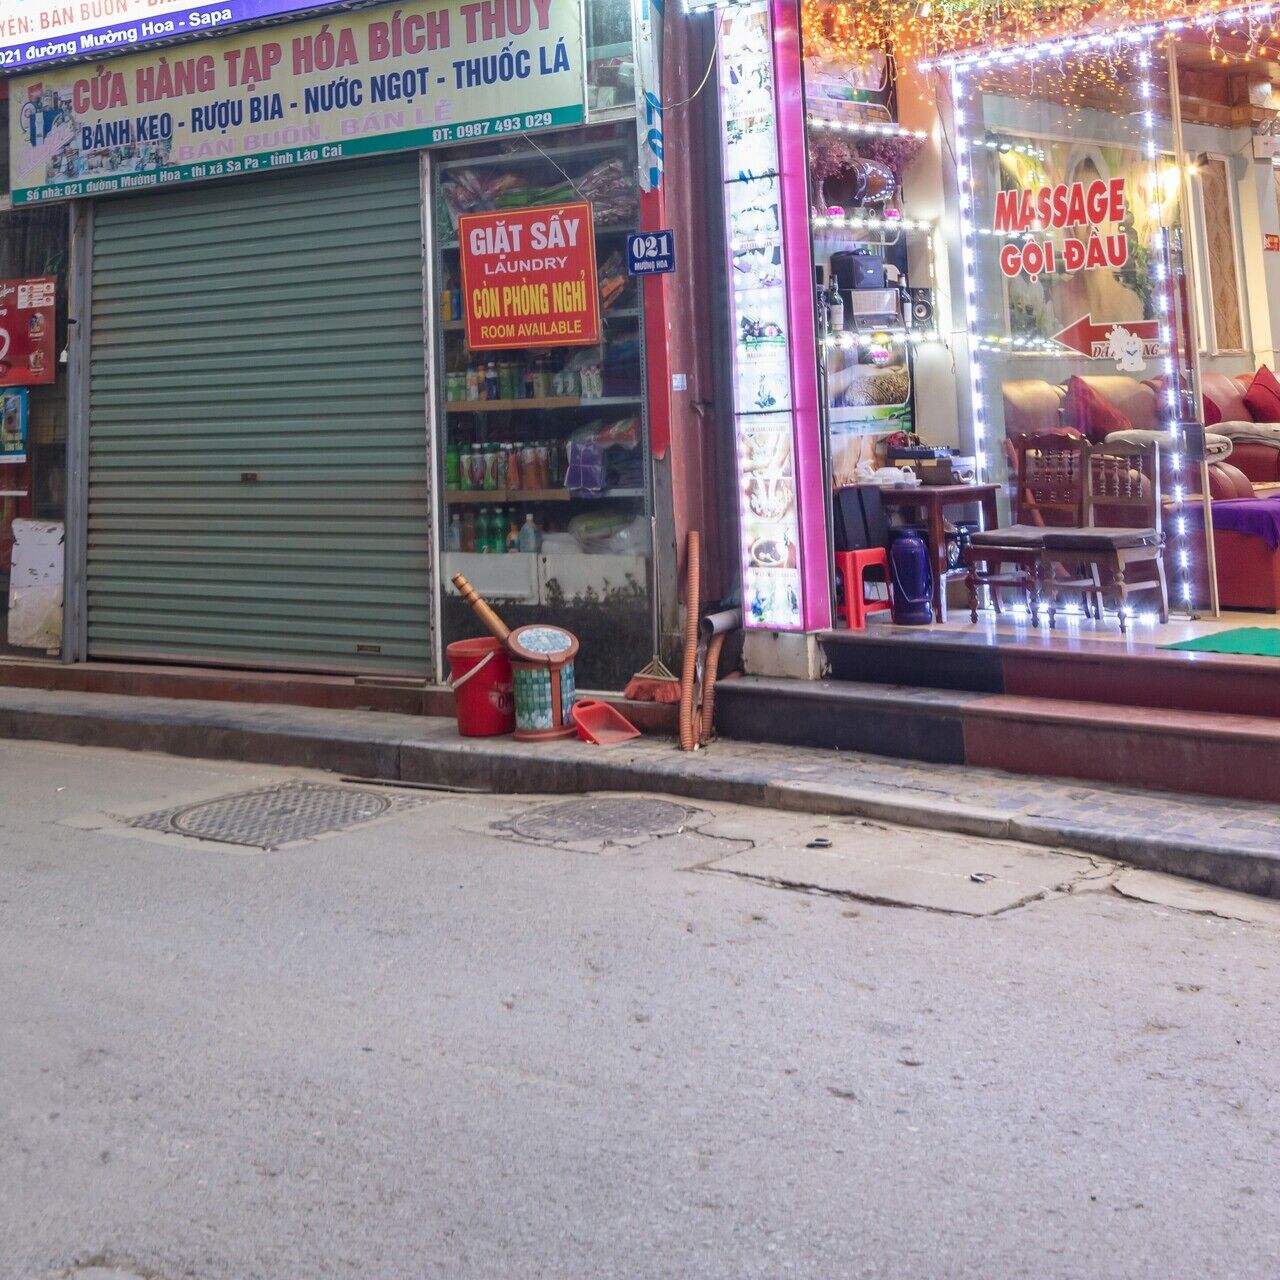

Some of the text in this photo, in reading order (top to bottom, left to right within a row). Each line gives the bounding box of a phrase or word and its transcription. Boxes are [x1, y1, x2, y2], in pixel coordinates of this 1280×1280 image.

[25, 34, 77, 62] đường
[80, 21, 138, 49] Mường
[144, 19, 175, 41] Hoa
[189, 8, 233, 32] Sapa
[72, 64, 128, 115] CỬA
[136, 55, 216, 104] HÀNG
[223, 42, 282, 92] TẠP
[292, 23, 359, 75] HÓA
[368, 9, 451, 62] BÍCH
[82, 36, 571, 151] BÁNH KẸO RƯỢU BIA NƯỚC NGỌT THUỐC LÁ
[178, 104, 405, 162] BÁN BÁN
[432, 112, 553, 142] ĐT: 0987 493 029
[26, 187, 39, 201] Số
[65, 184, 83, 196] 021
[159, 168, 181, 182] Hoa
[226, 158, 242, 173] Sa
[244, 156, 259, 170] Pa
[322, 143, 342, 158] Cai
[993, 177, 1127, 235] MASSAGE
[470, 210, 580, 259] GIẶT SẤY
[632, 234, 670, 259] 021
[999, 226, 1129, 283] GỘI ĐẦU
[484, 255, 568, 275] LAUNDRY
[472, 269, 587, 319] CÒN PHÒNG NGHỈ
[480, 319, 582, 339] ROOM AVAILABLE
